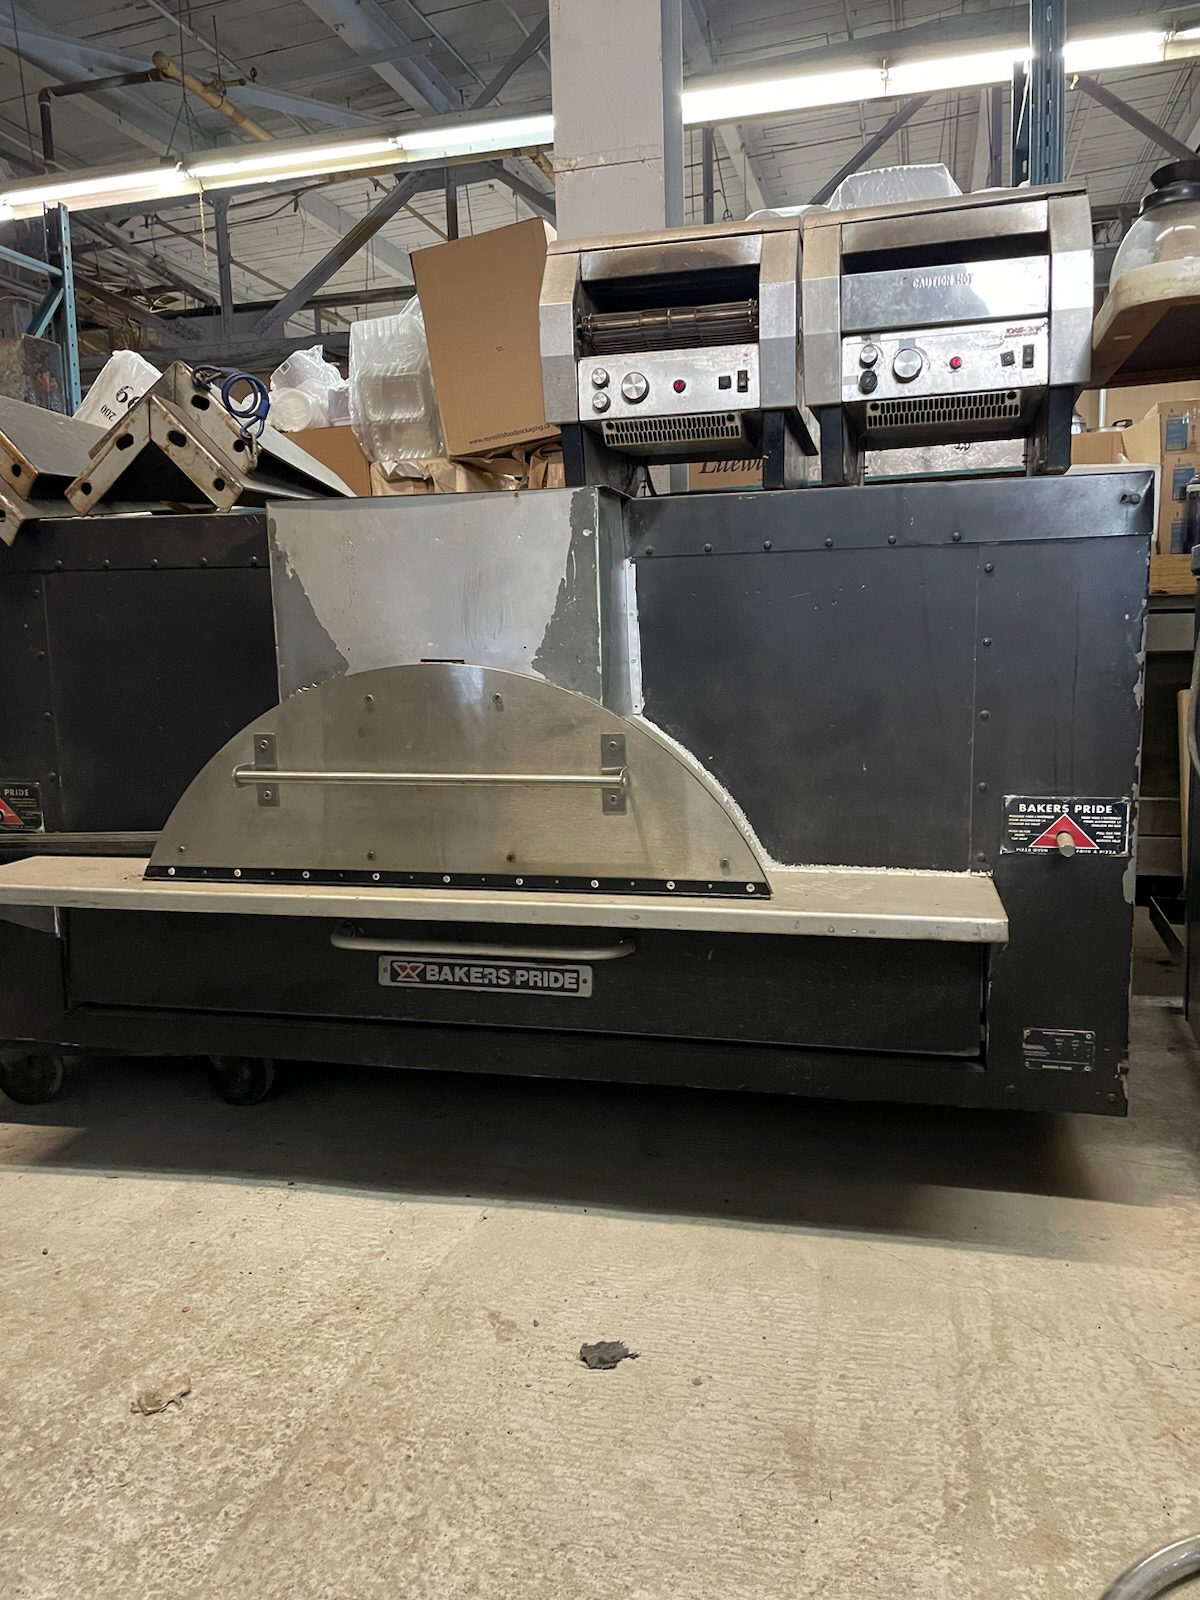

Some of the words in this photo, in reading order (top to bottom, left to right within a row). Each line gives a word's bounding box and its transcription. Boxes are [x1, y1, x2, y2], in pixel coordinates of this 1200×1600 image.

[912, 274, 954, 288] CAUTION
[4, 788, 29, 796] PRIDE
[1018, 803, 1070, 813] BAKERS
[1074, 804, 1113, 814] PRIDE
[425, 964, 511, 985] BAKERS
[514, 969, 579, 990] PRIDE
